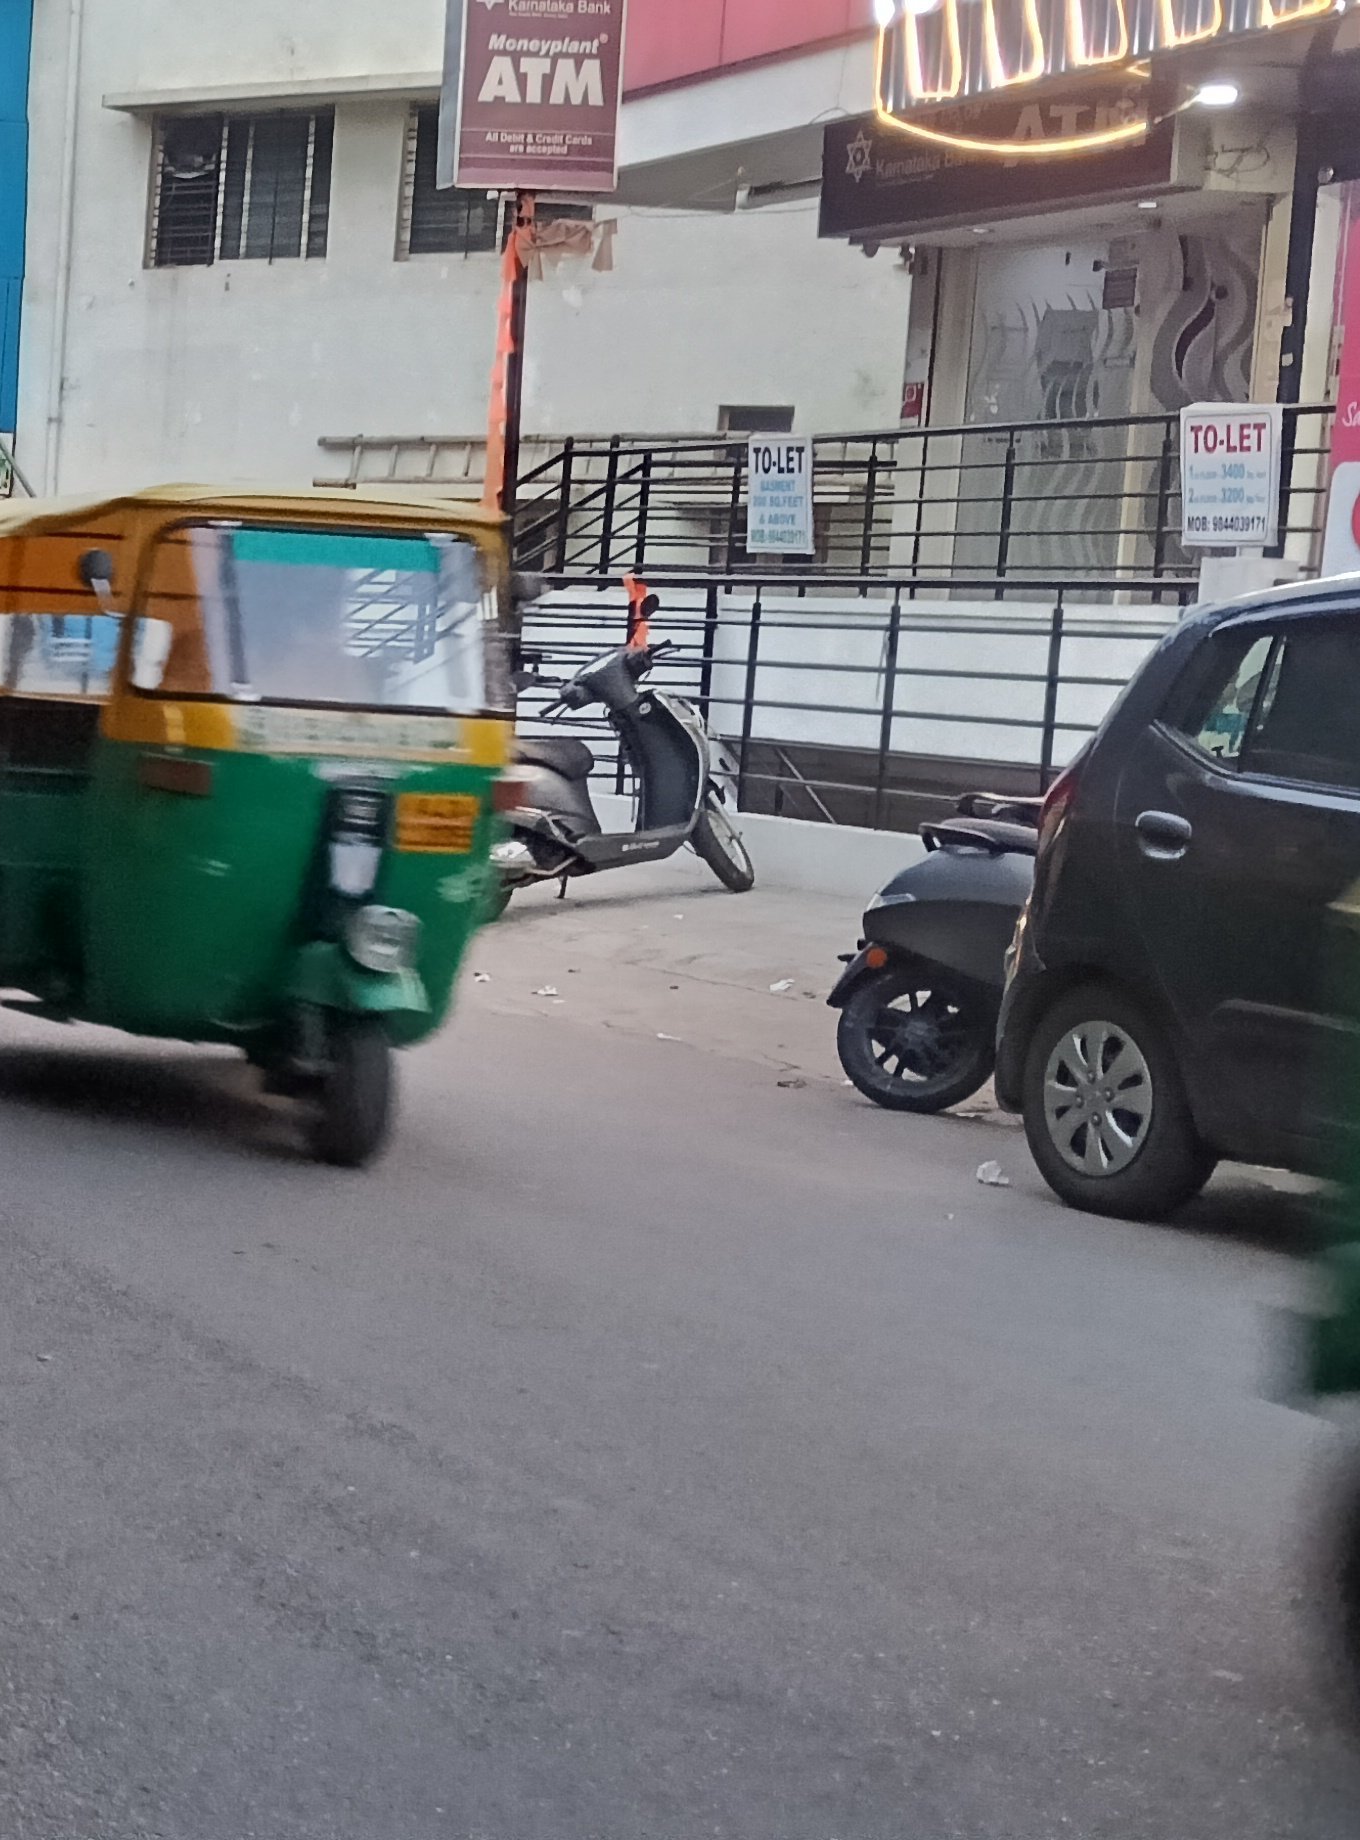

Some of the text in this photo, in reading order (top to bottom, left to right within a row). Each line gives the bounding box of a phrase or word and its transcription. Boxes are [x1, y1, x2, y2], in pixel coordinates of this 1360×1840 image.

[578, 1, 611, 14] Bank
[488, 34, 600, 56] Moneyplant
[478, 56, 604, 106] ATM
[535, 133, 563, 145] Credit
[1190, 422, 1266, 454] TO-LET
[752, 446, 805, 475] TO-LET
